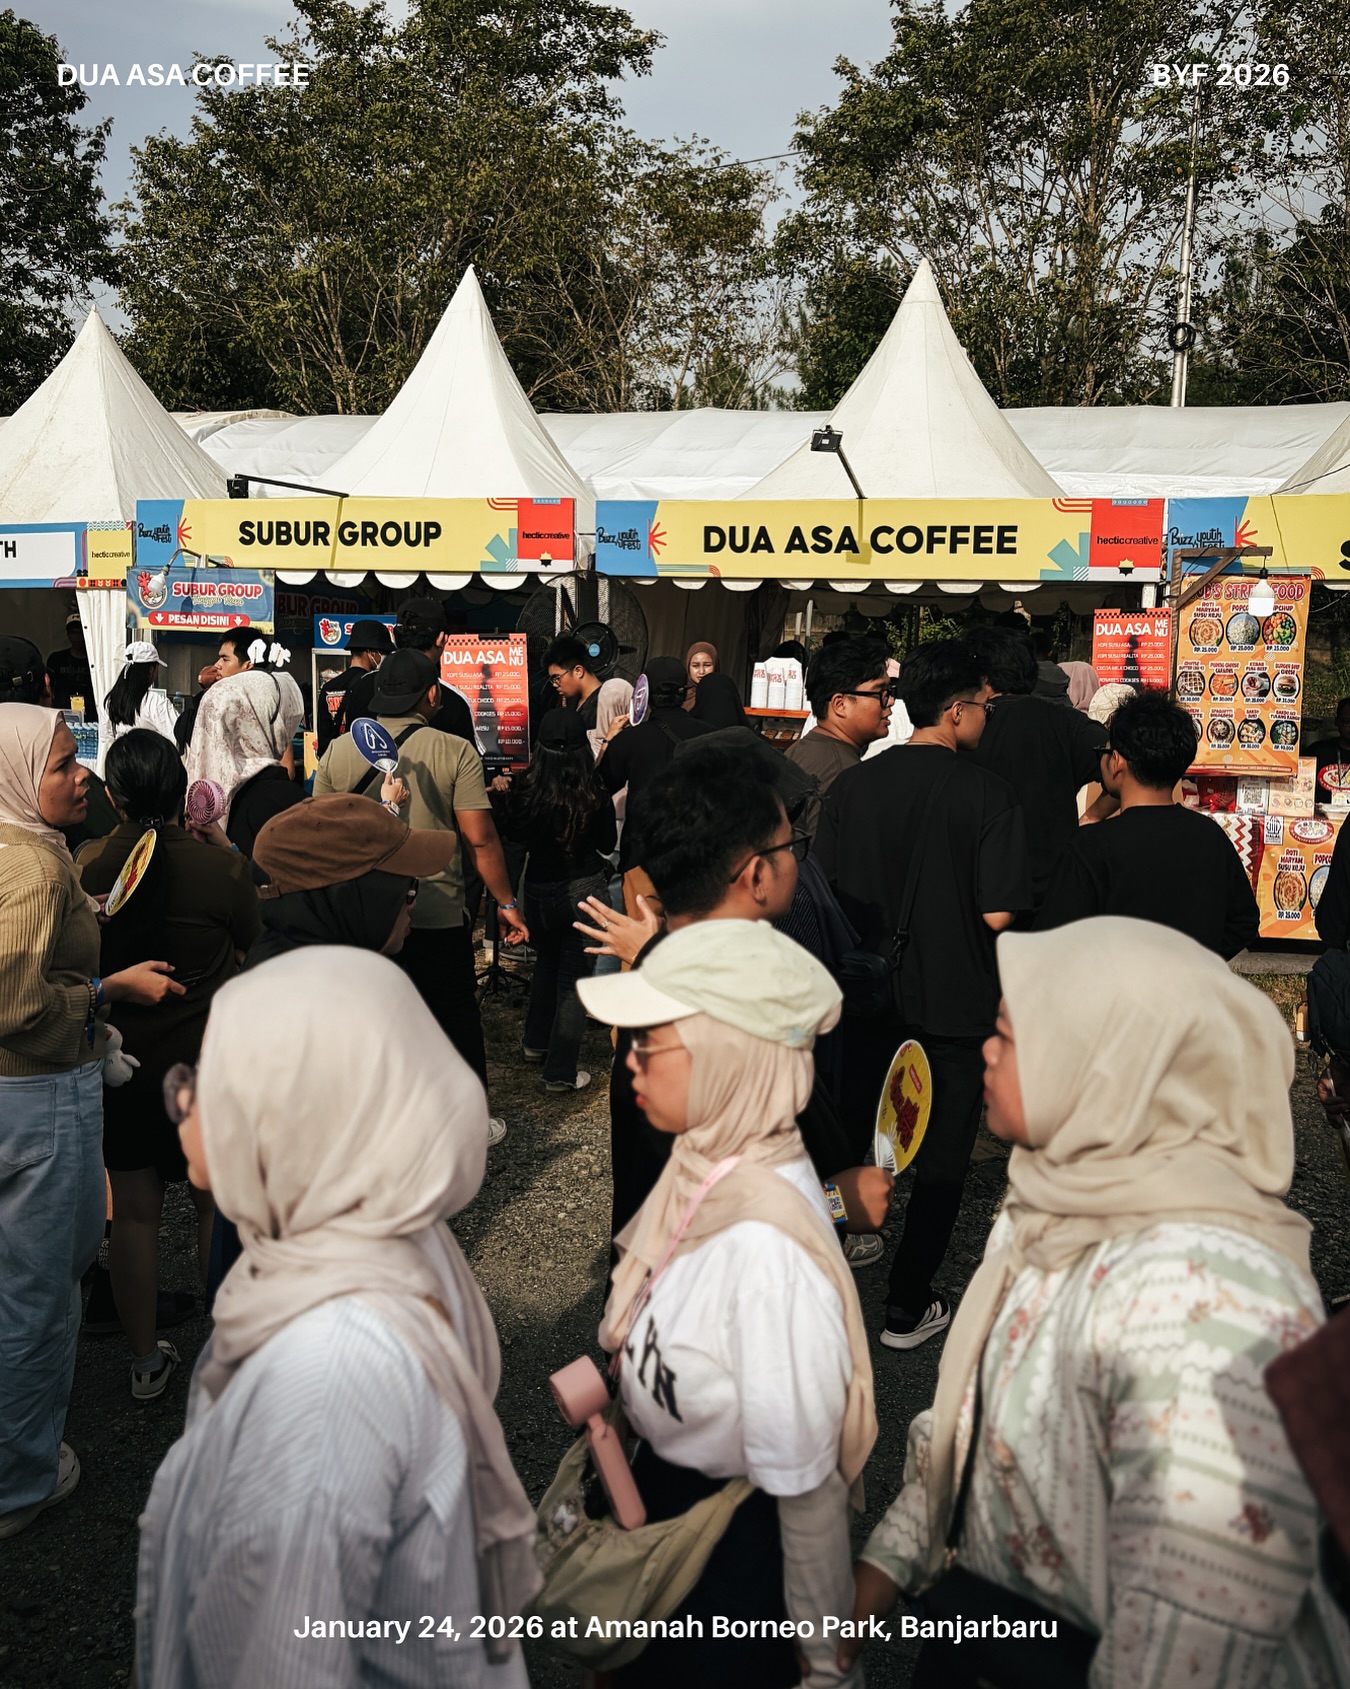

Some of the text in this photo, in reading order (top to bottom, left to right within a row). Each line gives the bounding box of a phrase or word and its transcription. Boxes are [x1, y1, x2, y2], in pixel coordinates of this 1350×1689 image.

[238, 520, 442, 547] SUBUR GROUP
[522, 531, 570, 540] hecticcreative
[703, 525, 1018, 554] DUA ASA COFFEE
[1096, 536, 1159, 545] hecticcreative
[91, 551, 131, 559] hecticcreative
[173, 583, 263, 598] SUBUR GROUP
[1271, 584, 1304, 600] FOOD
[168, 614, 229, 626] PESAN DISINI
[1154, 619, 1168, 628] ME
[1096, 623, 1152, 636] DUA ASA
[1154, 628, 1168, 637] NU
[509, 647, 523, 656] ME
[443, 651, 506, 664] DUA ASA
[509, 657, 524, 666] NU
